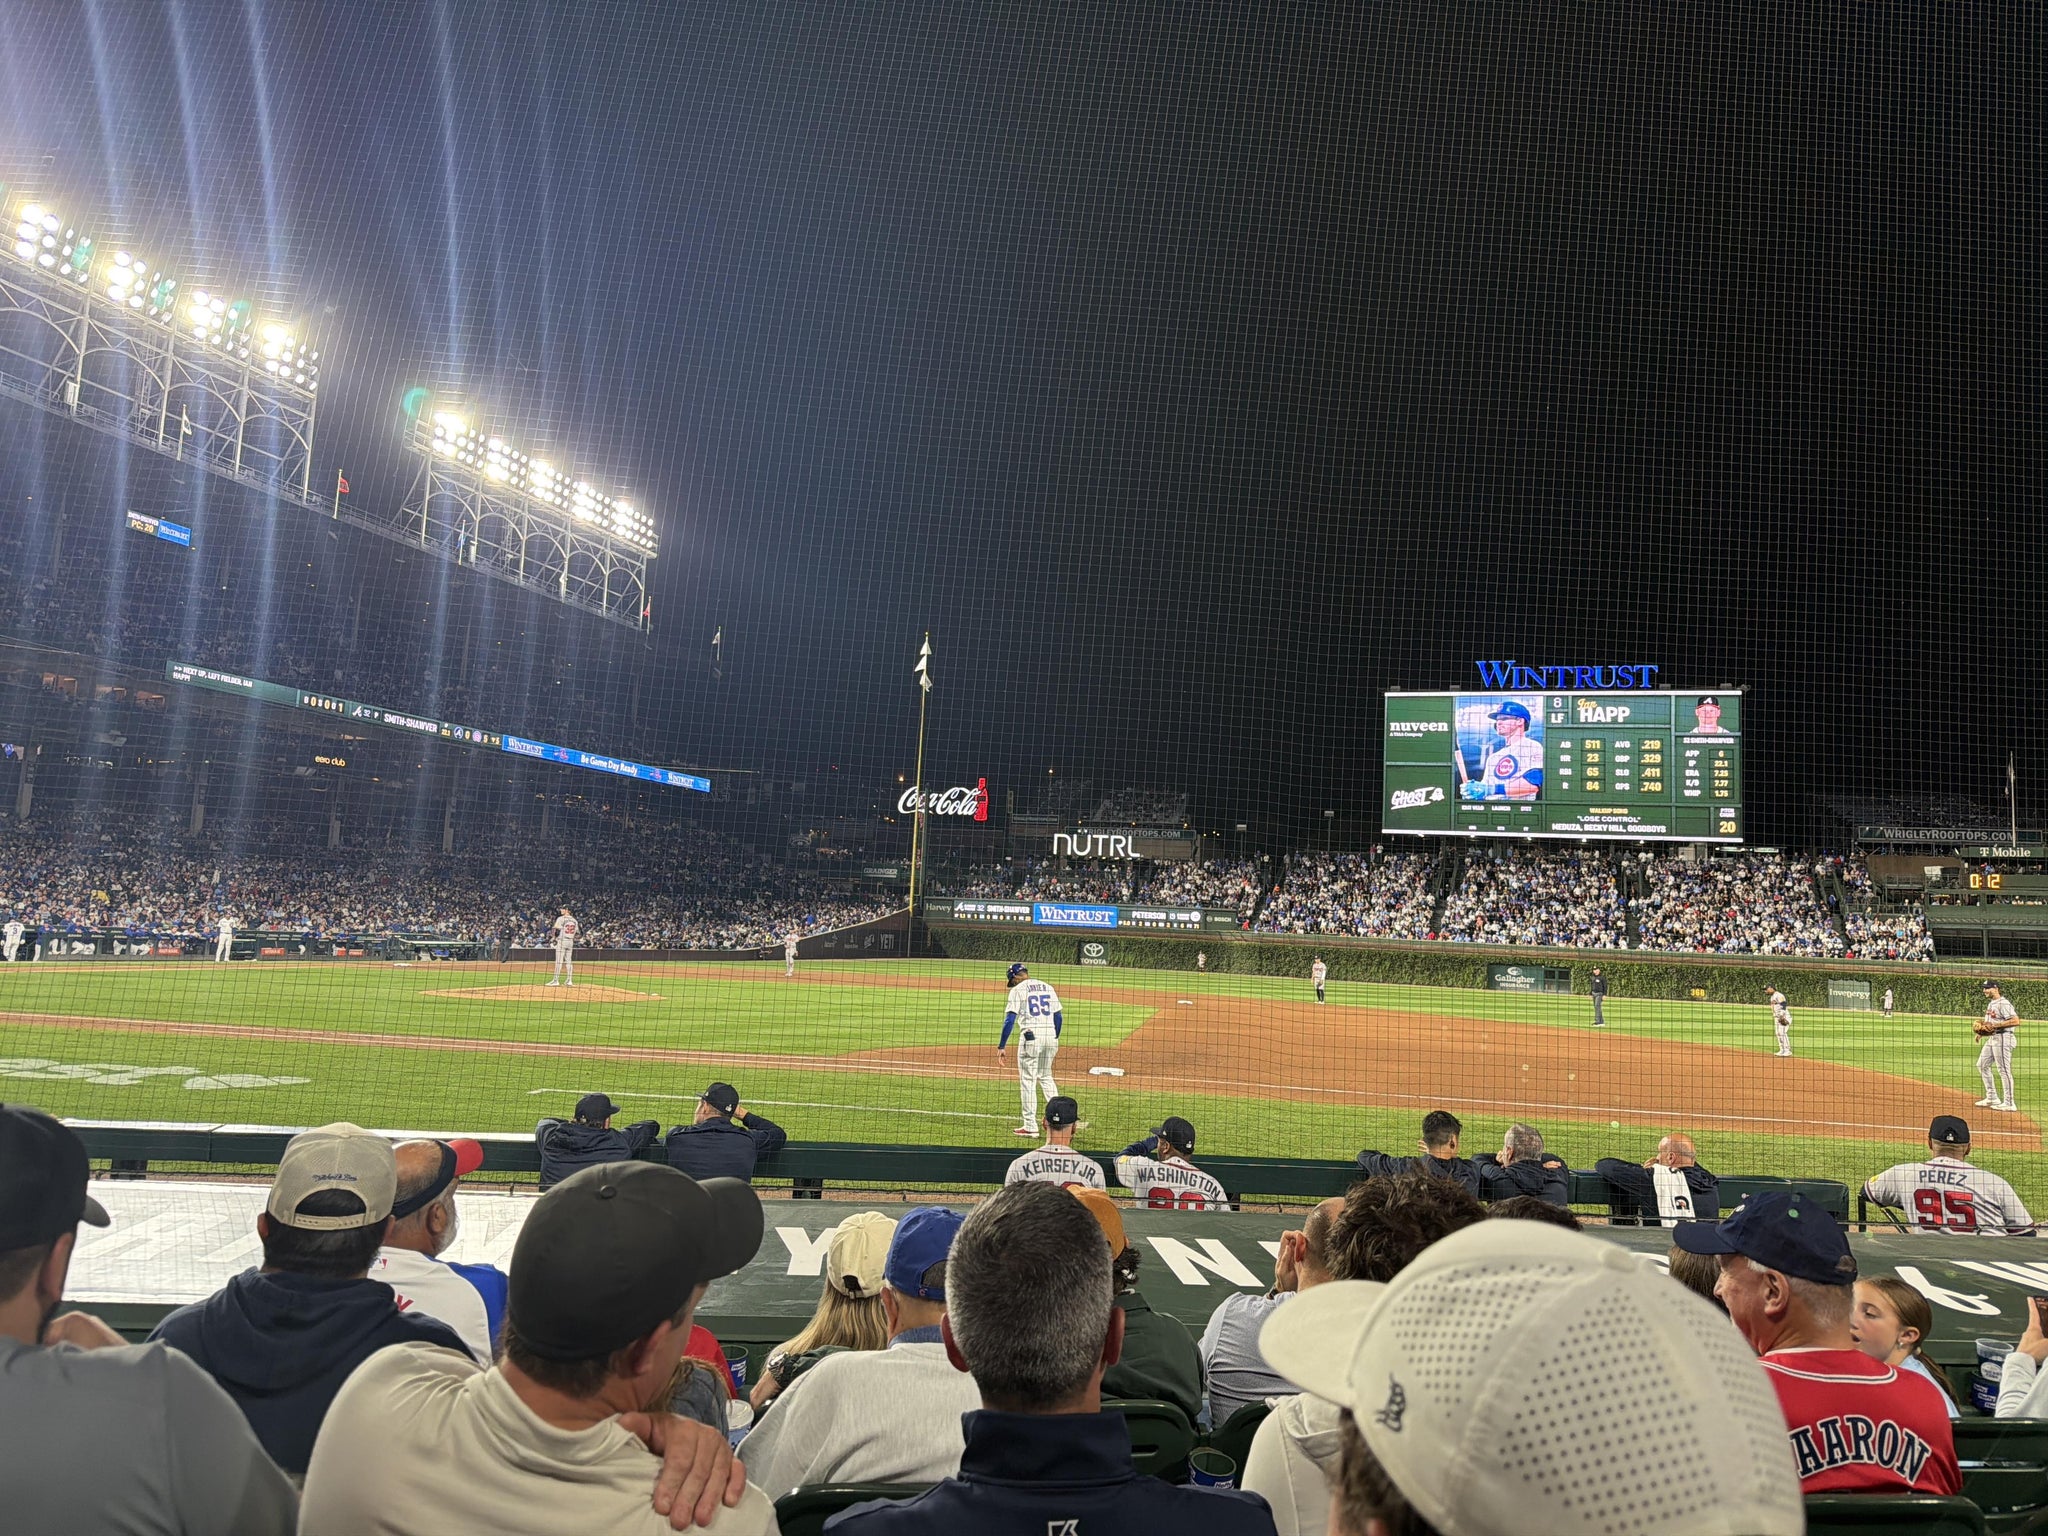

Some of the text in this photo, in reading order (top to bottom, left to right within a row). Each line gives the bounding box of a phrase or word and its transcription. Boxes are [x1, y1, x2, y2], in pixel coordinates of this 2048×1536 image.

[144, 523, 154, 533] 20
[208, 672, 221, 681] LEFT
[1475, 659, 1659, 689] WINTRUST
[311, 697, 316, 707] 0
[324, 700, 330, 710] 0
[338, 703, 344, 713] 1
[1553, 697, 1562, 708] 8
[1551, 713, 1565, 724] LF
[1580, 706, 1630, 723] HAPP
[363, 708, 371, 718] 32
[384, 713, 438, 733] SMITH-SHAWVER
[1389, 721, 1449, 732] nuveen
[465, 730, 470, 740] 0
[508, 737, 545, 755] WINTRUST
[1560, 740, 1601, 749] AB 511
[1641, 740, 1661, 750] .219
[315, 755, 346, 767] eero club
[1586, 753, 1600, 763] 23
[1640, 754, 1662, 764] .329
[580, 754, 638, 776] Be Game Day Ready
[1586, 767, 1600, 777] 65
[1641, 768, 1661, 778] .411
[1685, 769, 1700, 777] ERA
[1586, 781, 1600, 791] 84
[1640, 782, 1662, 792] .740
[1390, 787, 1436, 808] GHOST
[1584, 824, 1608, 832] BECKY
[1719, 821, 1736, 833] 20
[1992, 847, 2031, 857] Mobile
[1969, 873, 2001, 889] 0:12
[926, 902, 952, 913] Harvey
[976, 904, 985, 912] 32
[1039, 905, 1113, 921] WINTRUST
[1131, 911, 1167, 920] PETERSON
[879, 934, 895, 949] YETI
[1495, 974, 1535, 984] Gallagher
[1028, 994, 1051, 1017] 65
[1022, 1158, 1096, 1182] KEIRSEY JR
[1137, 1167, 1221, 1199] WASHINGTON
[1913, 1188, 1977, 1233] 95
[1788, 1414, 1933, 1486] AARON
